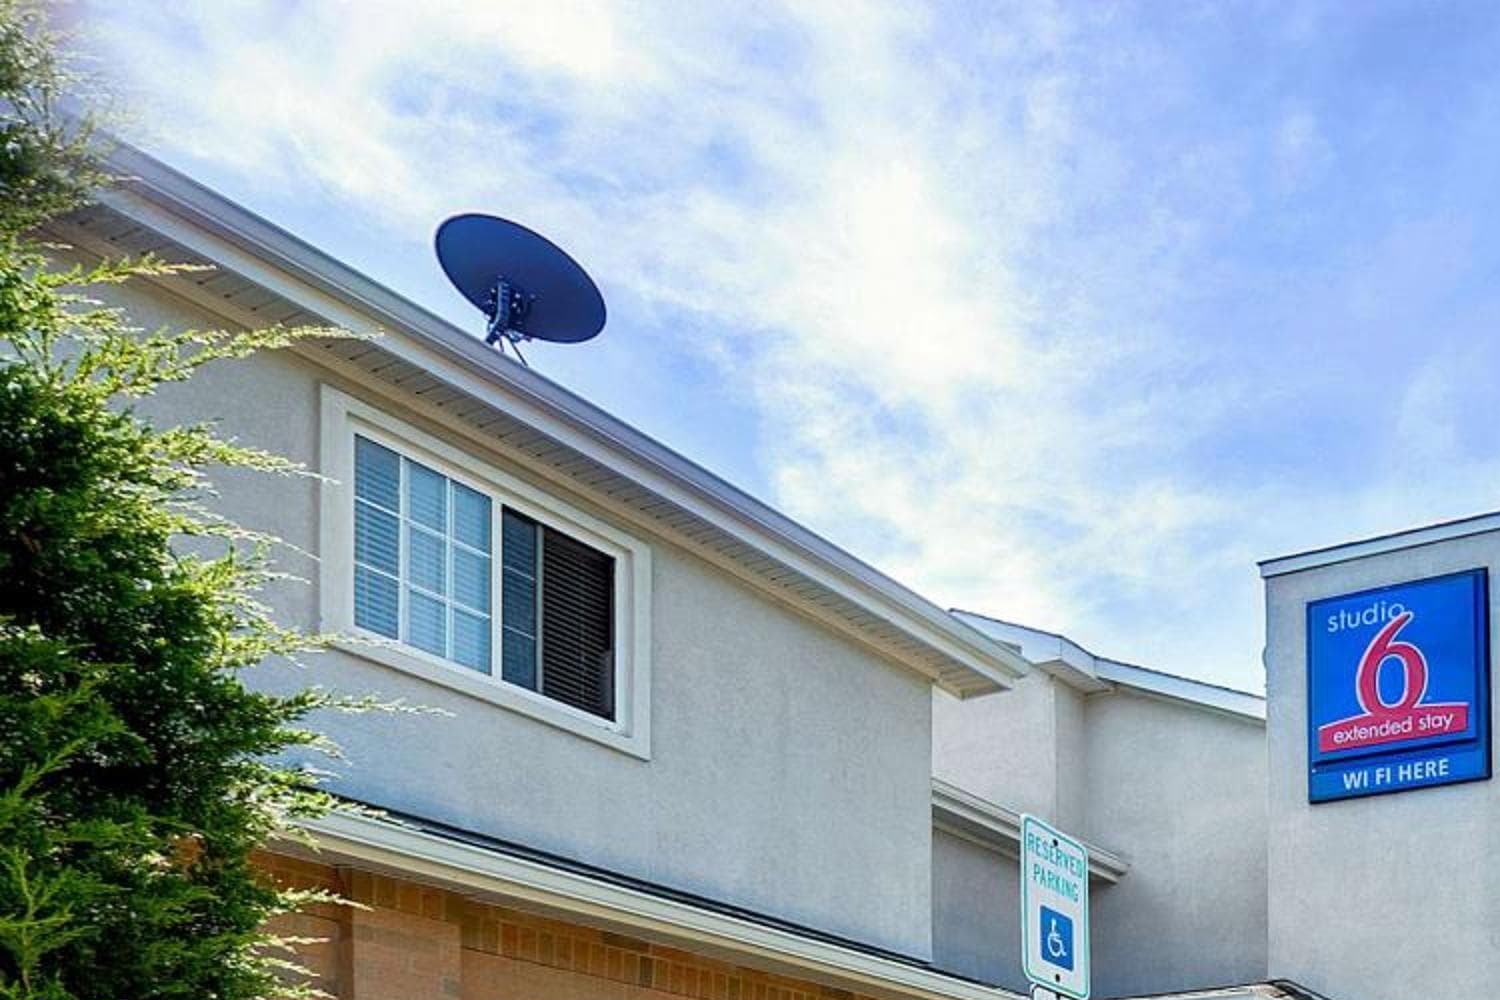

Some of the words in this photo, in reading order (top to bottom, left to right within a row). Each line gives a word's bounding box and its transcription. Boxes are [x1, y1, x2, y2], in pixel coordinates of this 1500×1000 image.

[1327, 600, 1405, 632] studio
[1356, 610, 1428, 714] 6
[1333, 715, 1413, 744] extended
[1418, 713, 1454, 732] stay
[1343, 769, 1368, 790] WI
[1376, 766, 1391, 785] FI
[1400, 758, 1450, 782] HERE
[1027, 833, 1083, 879] RESERVED
[1033, 863, 1079, 902] PARKING
